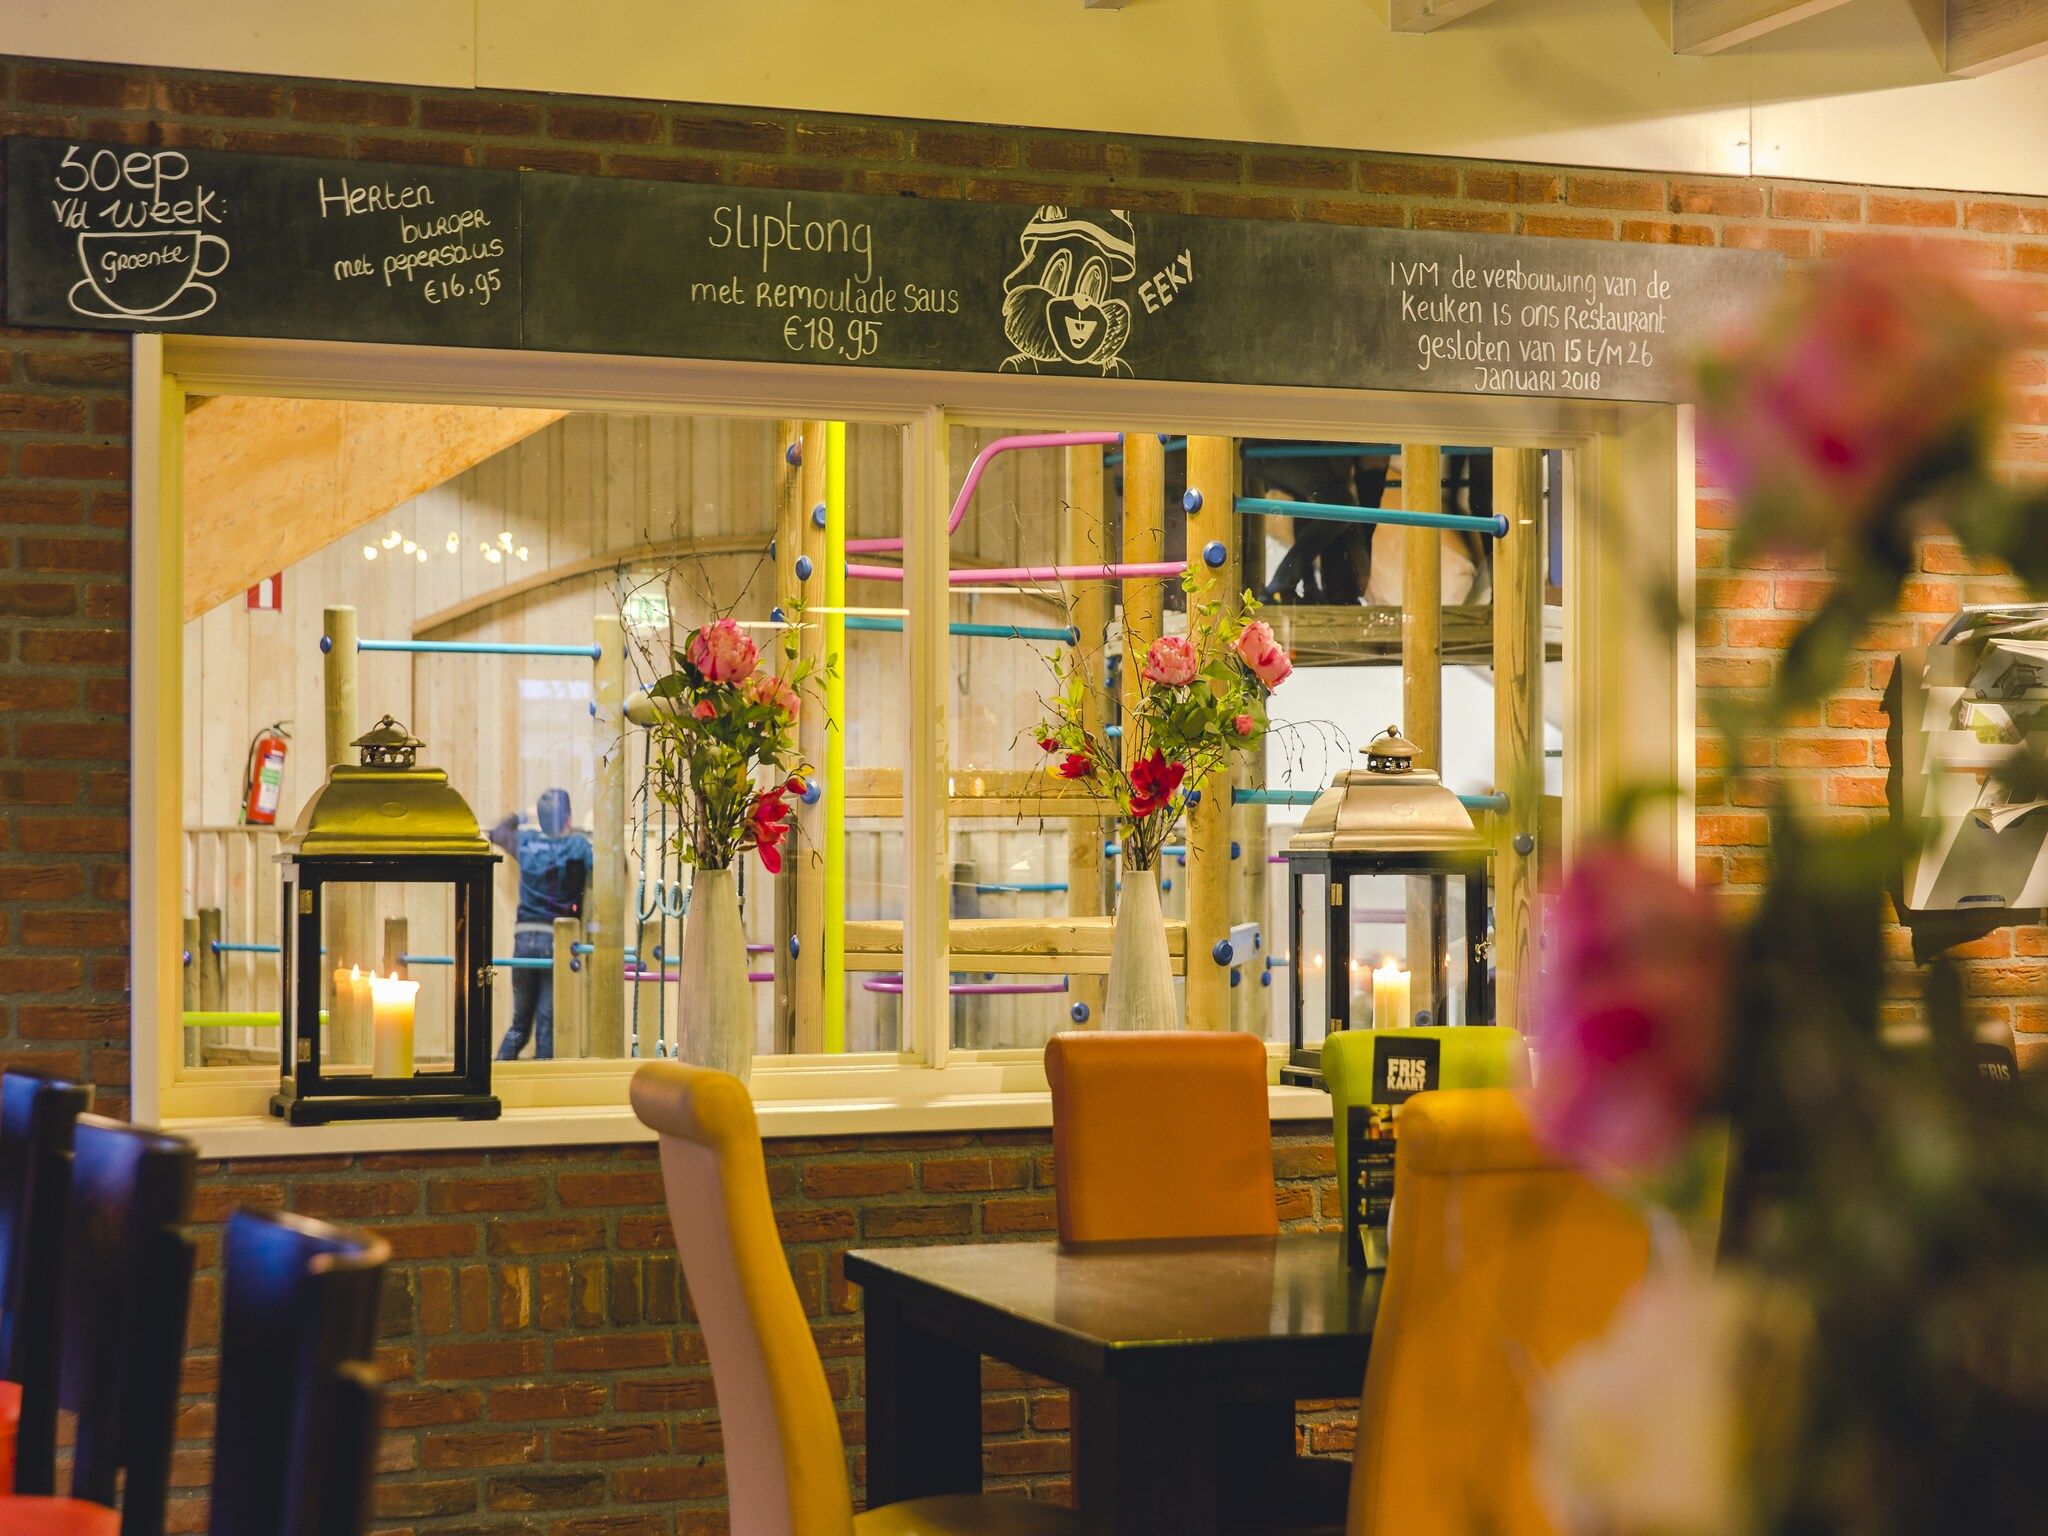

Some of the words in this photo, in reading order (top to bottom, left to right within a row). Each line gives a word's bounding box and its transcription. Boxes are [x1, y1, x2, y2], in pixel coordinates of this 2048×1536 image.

[400, 209, 492, 247] burger
[708, 201, 873, 283] Sliptong
[333, 253, 375, 281] met
[383, 238, 505, 287] pepersaus
[691, 275, 745, 305] met
[1390, 261, 1439, 287] IVM
[1452, 253, 1478, 289] de
[1483, 259, 1597, 306] verbouwing
[1603, 275, 1637, 297] van
[1646, 269, 1671, 300] de
[1521, 304, 1560, 329] ons
[1417, 328, 1511, 371] gesloten
[1518, 339, 1556, 363] van
[1564, 338, 1582, 364] 15
[1626, 339, 1654, 367] 26
[1561, 369, 1601, 391] 2018
[1386, 1075, 1426, 1091] KAART
[1387, 1058, 1426, 1078] FRIS
[1978, 1063, 2011, 1081] FRIS
